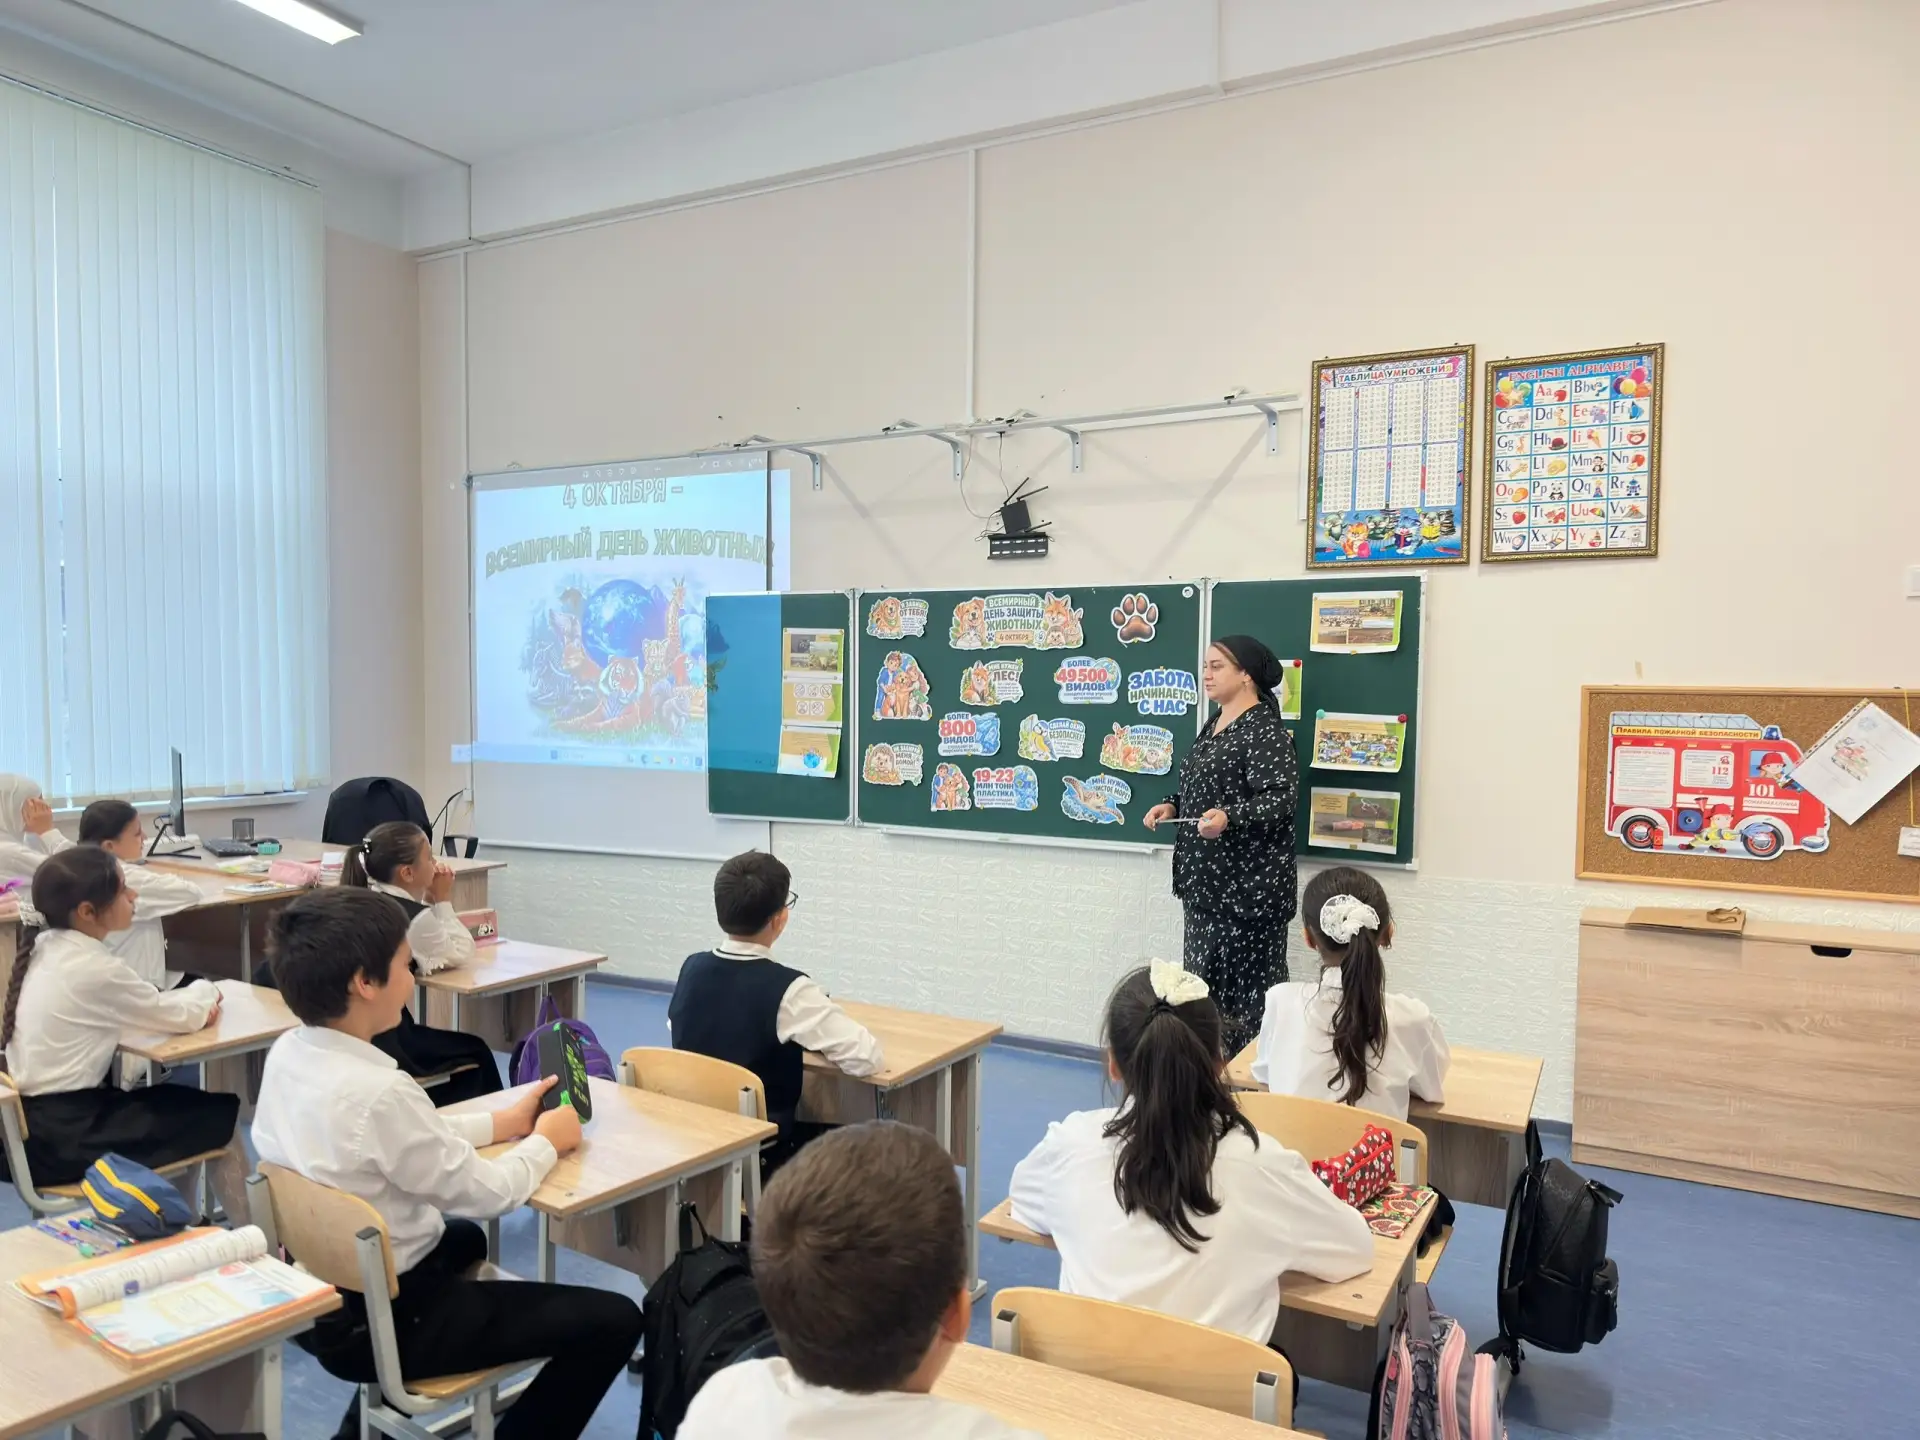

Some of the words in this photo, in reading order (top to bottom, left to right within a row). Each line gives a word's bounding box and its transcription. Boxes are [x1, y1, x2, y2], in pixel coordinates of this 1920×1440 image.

[1339, 371, 1385, 382] ТАБЛИЦА
[1386, 364, 1453, 378] УМНОЖЕНИЯ
[1508, 368, 1564, 382] ENGLISH
[1568, 360, 1640, 376] ALPHABET
[563, 485, 576, 509] 4
[582, 478, 666, 506] ОКТЯБРЯ
[486, 527, 592, 579] ВСЕМИРНЫЙ
[596, 530, 648, 560] ДЕНЬ
[653, 528, 774, 567] ЖИВОТНЫХ
[989, 596, 1036, 607] ВСЕМИРНЫЙ
[984, 609, 1004, 620] ДЕНЬ
[1006, 608, 1044, 619] ЗАЩИТЫ
[986, 619, 1042, 630] ЖИВОТНЫХ
[993, 671, 1019, 682] ЛЕС!
[1130, 670, 1195, 690] ЗАБОТА
[1066, 682, 1105, 692] ВИДОВ
[1130, 687, 1196, 702] НАЧИНАЕТСЯ
[1140, 700, 1150, 713] С
[1154, 700, 1185, 713] НАС
[941, 720, 976, 736] 800
[1712, 766, 1728, 775] 112
[1749, 784, 1775, 797] 101
